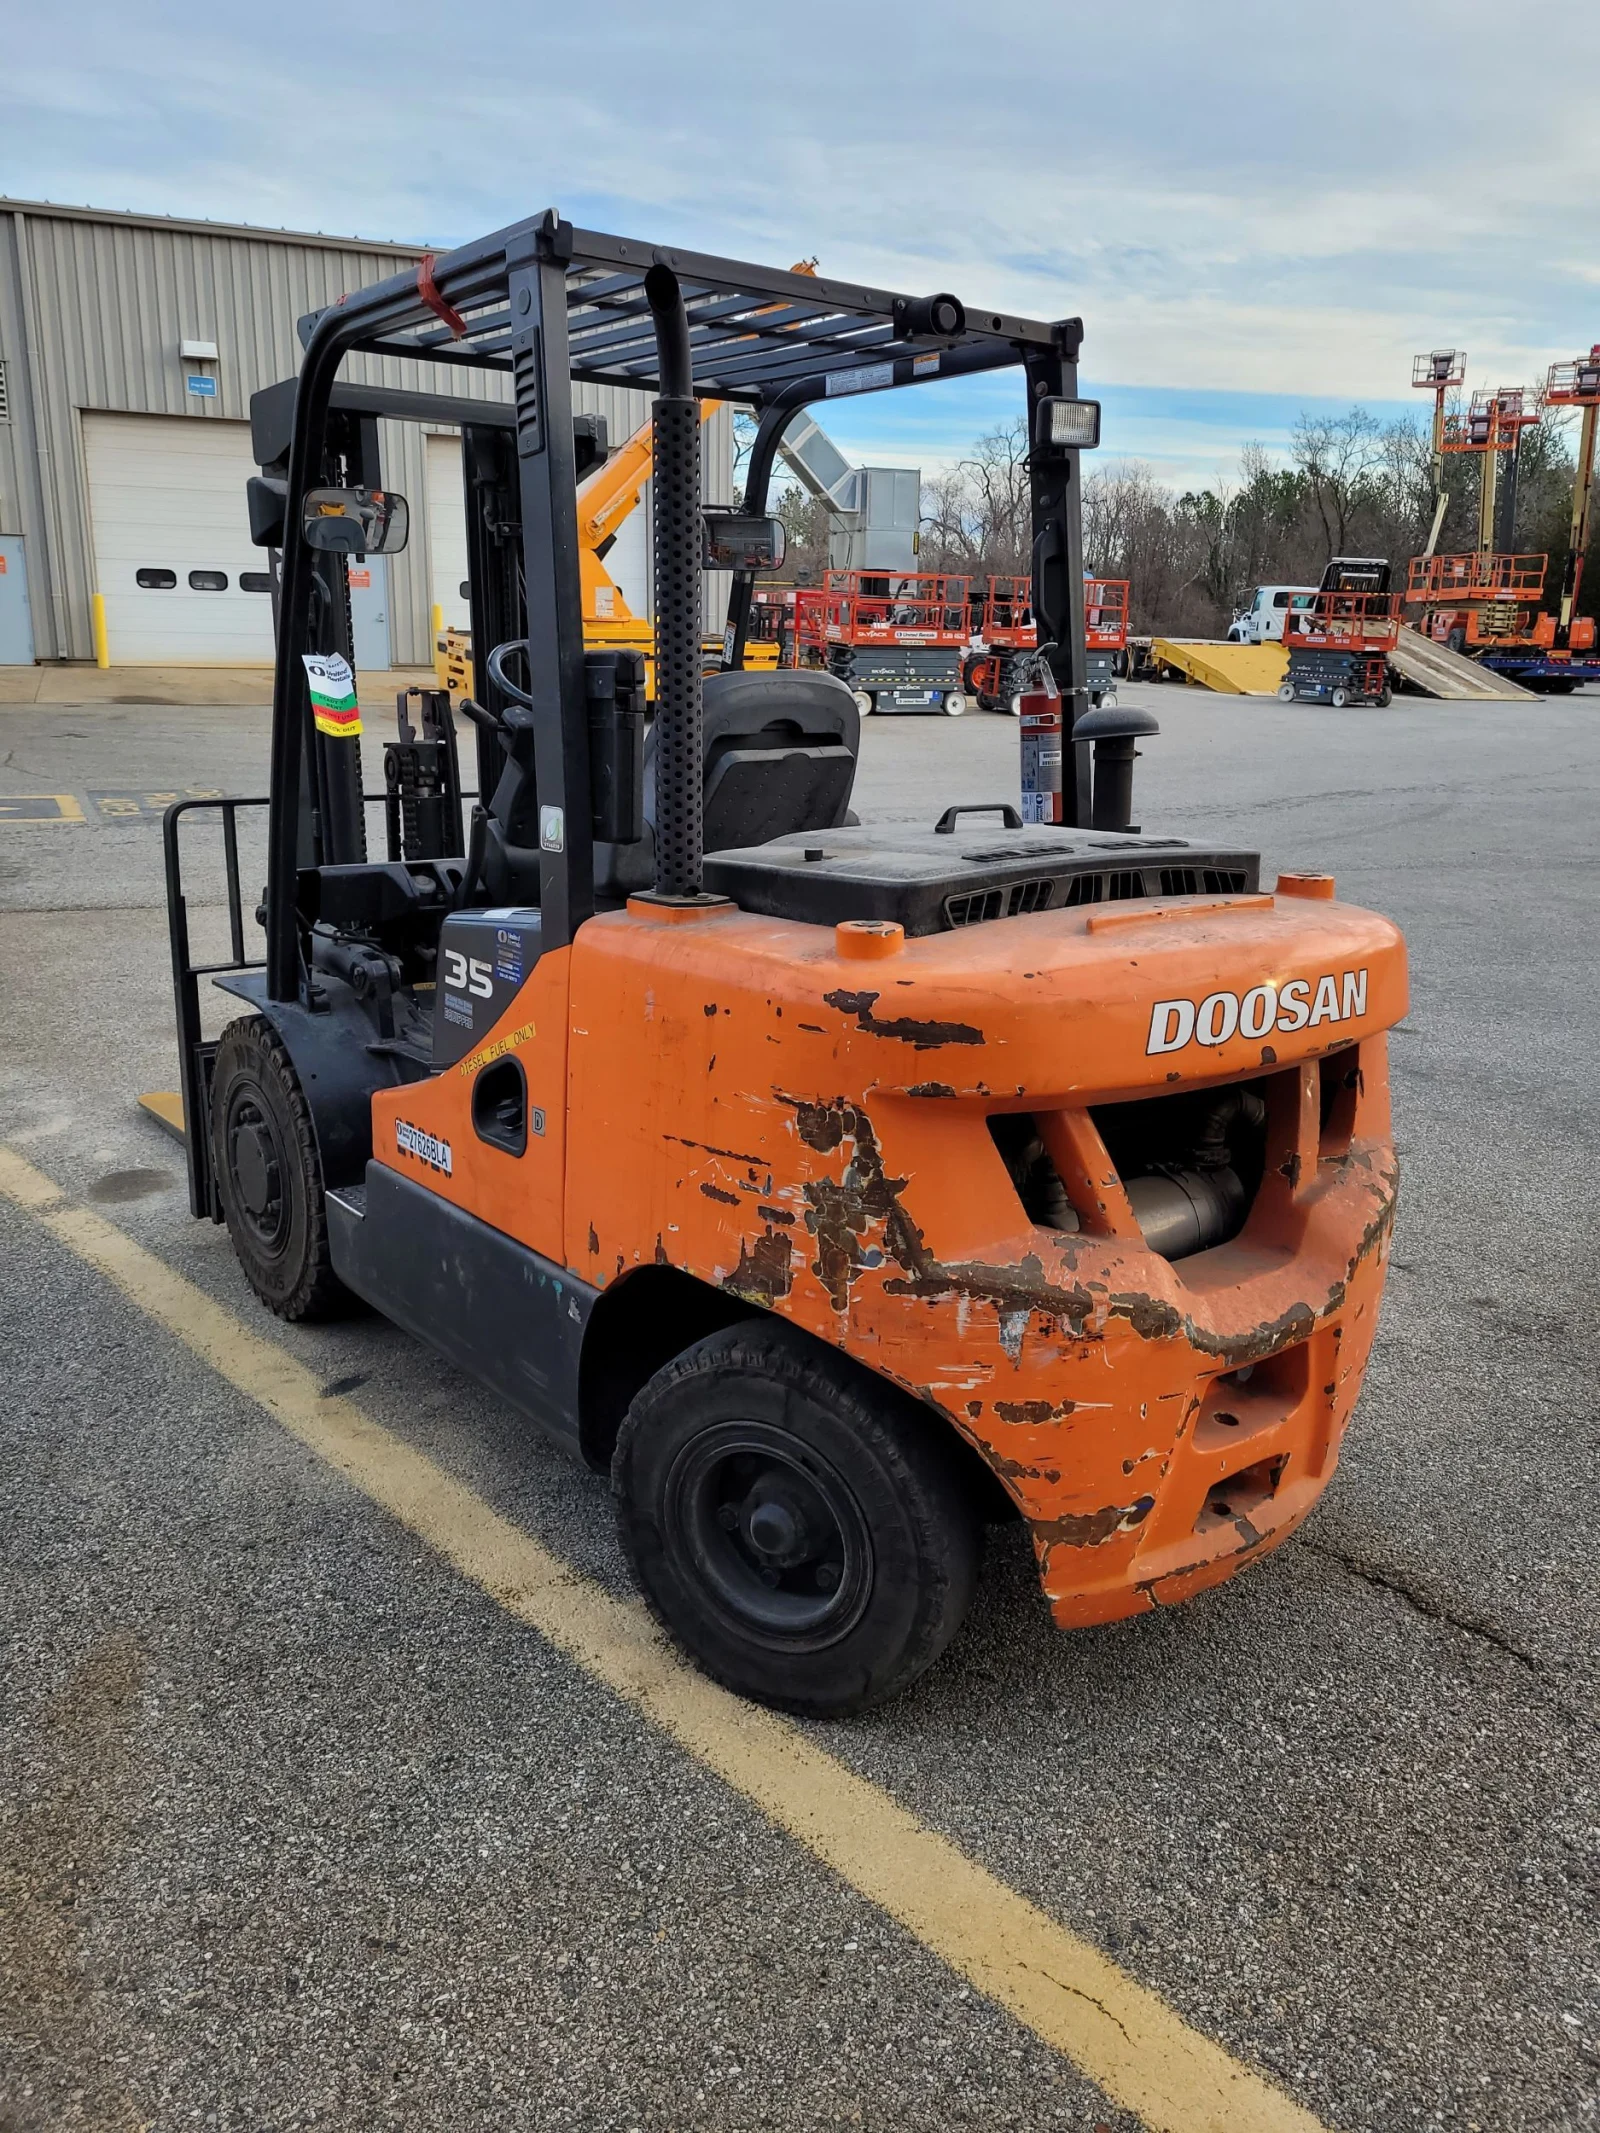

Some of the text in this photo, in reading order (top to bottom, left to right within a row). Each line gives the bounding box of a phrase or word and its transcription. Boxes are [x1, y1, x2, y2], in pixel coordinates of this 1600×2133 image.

[326, 667, 348, 677] United
[327, 673, 351, 682] Rentals
[318, 695, 338, 705] READY
[326, 702, 343, 711] RENT
[342, 725, 357, 733] OUT
[445, 949, 493, 999] 35
[1146, 968, 1368, 1056] DOOSAN
[460, 1023, 536, 1077] DIESEL FUEL ONLY
[409, 1129, 448, 1168] 27626BLA
